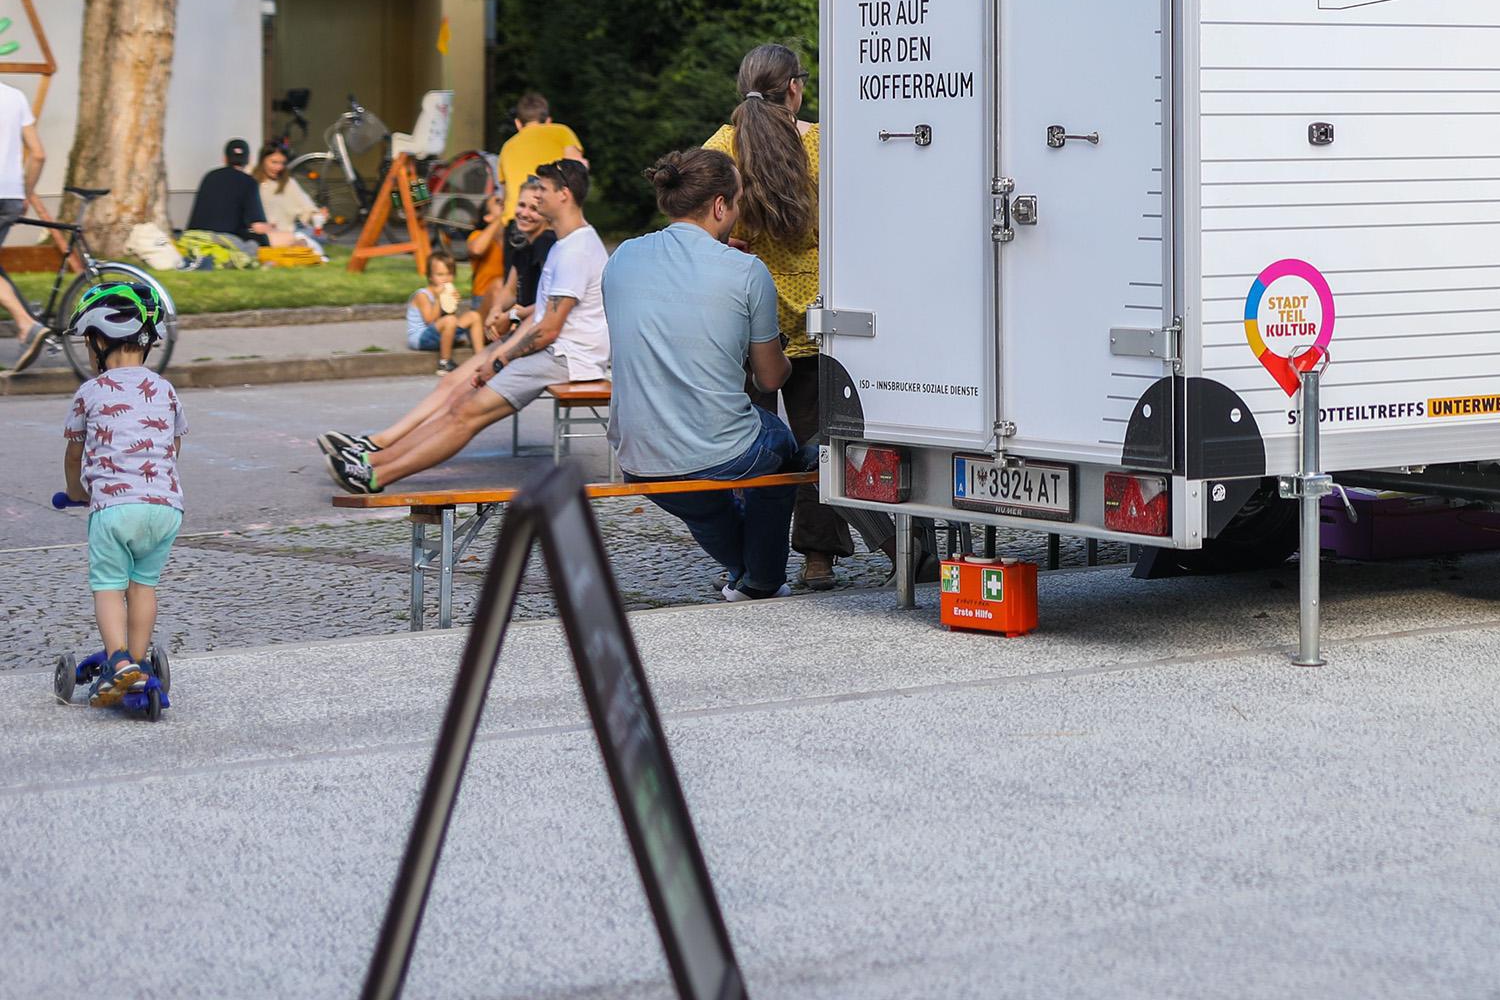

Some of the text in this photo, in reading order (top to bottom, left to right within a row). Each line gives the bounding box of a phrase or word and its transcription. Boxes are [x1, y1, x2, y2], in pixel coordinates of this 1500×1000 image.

[896, 0, 929, 25] AUF
[858, 31, 931, 64] FÜR DEN
[859, 72, 974, 101] KOFFERRAUM
[1268, 296, 1308, 310] STADT
[1278, 309, 1306, 323] TEIL
[1266, 322, 1316, 337] KULTUR
[860, 379, 870, 389] ISD
[876, 381, 921, 393] INNSBRUCKER
[922, 383, 949, 395] SOZIALE
[950, 385, 979, 397] DIENSTE
[953, 606, 993, 619] Erste Hilfe
